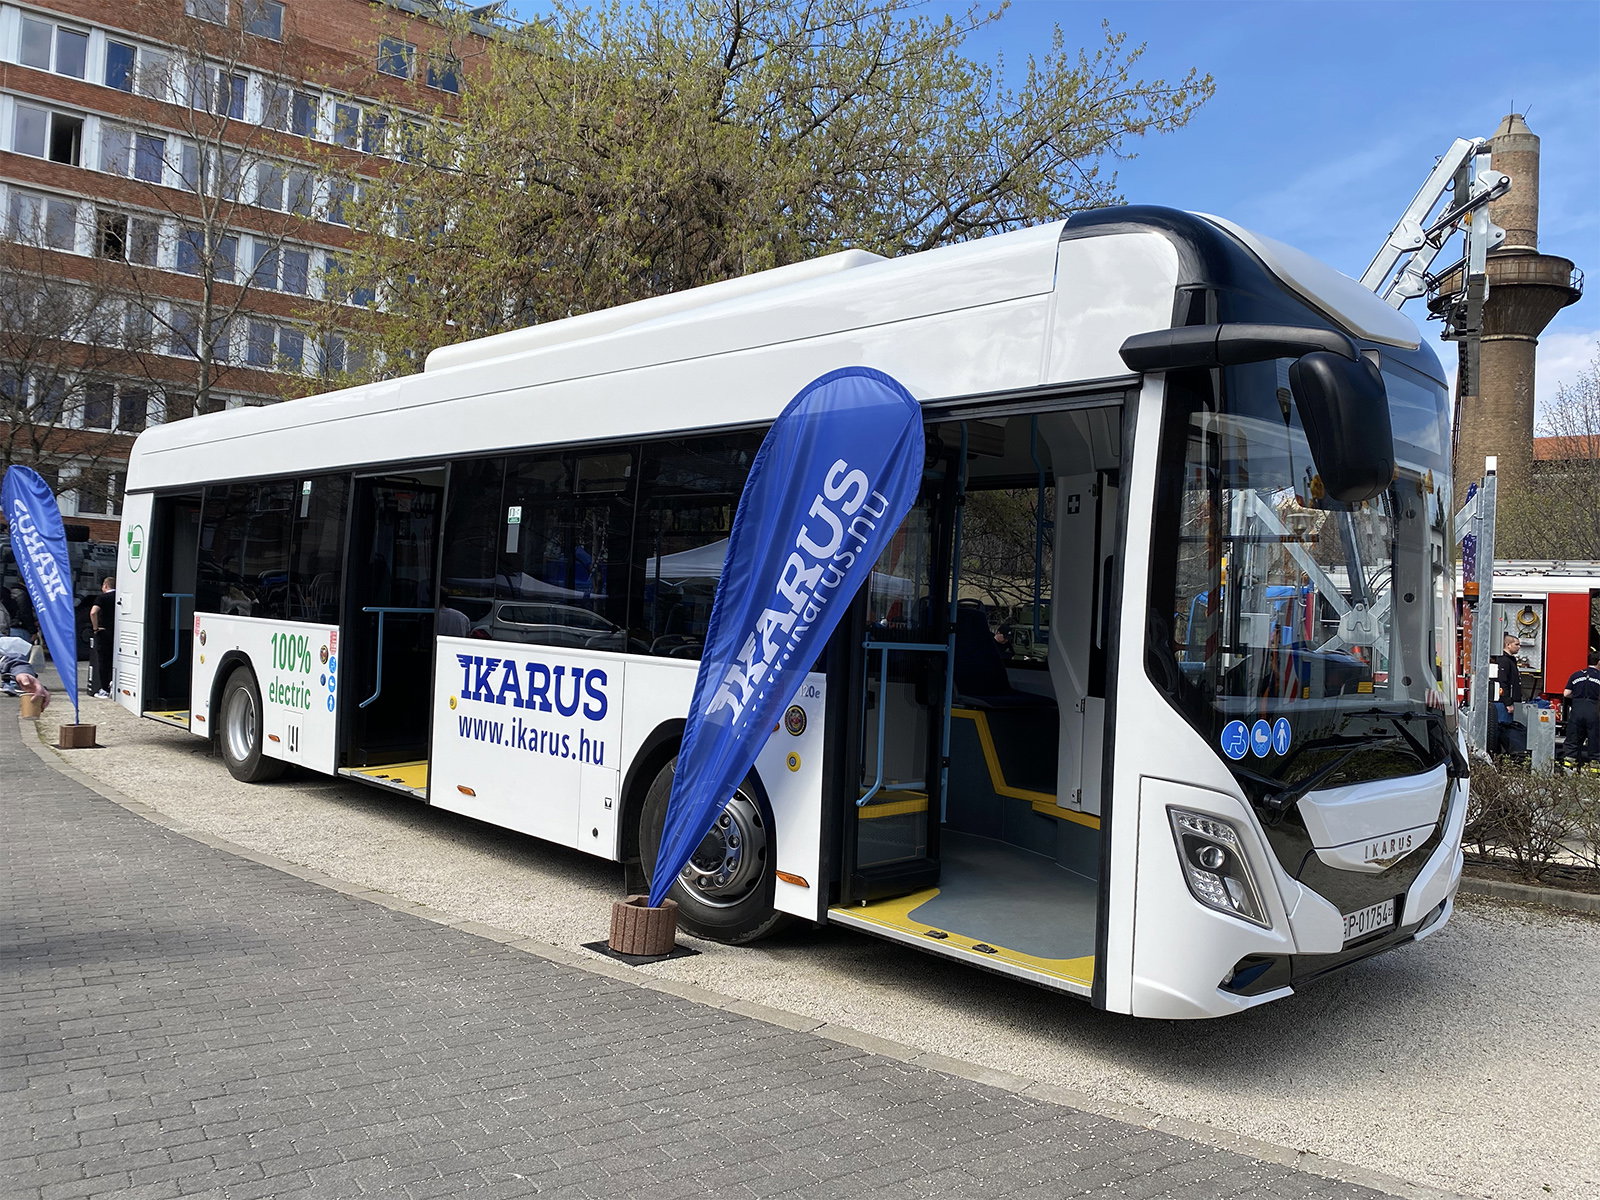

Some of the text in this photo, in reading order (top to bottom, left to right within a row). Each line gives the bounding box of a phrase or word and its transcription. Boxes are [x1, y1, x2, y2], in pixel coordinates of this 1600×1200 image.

[706, 458, 869, 725] IKARUS
[271, 632, 311, 674] 100%
[269, 675, 311, 710] electric
[456, 654, 608, 721] IKARUS
[459, 715, 605, 765] www.ikarus.hu
[1364, 834, 1412, 859] IKARUS
